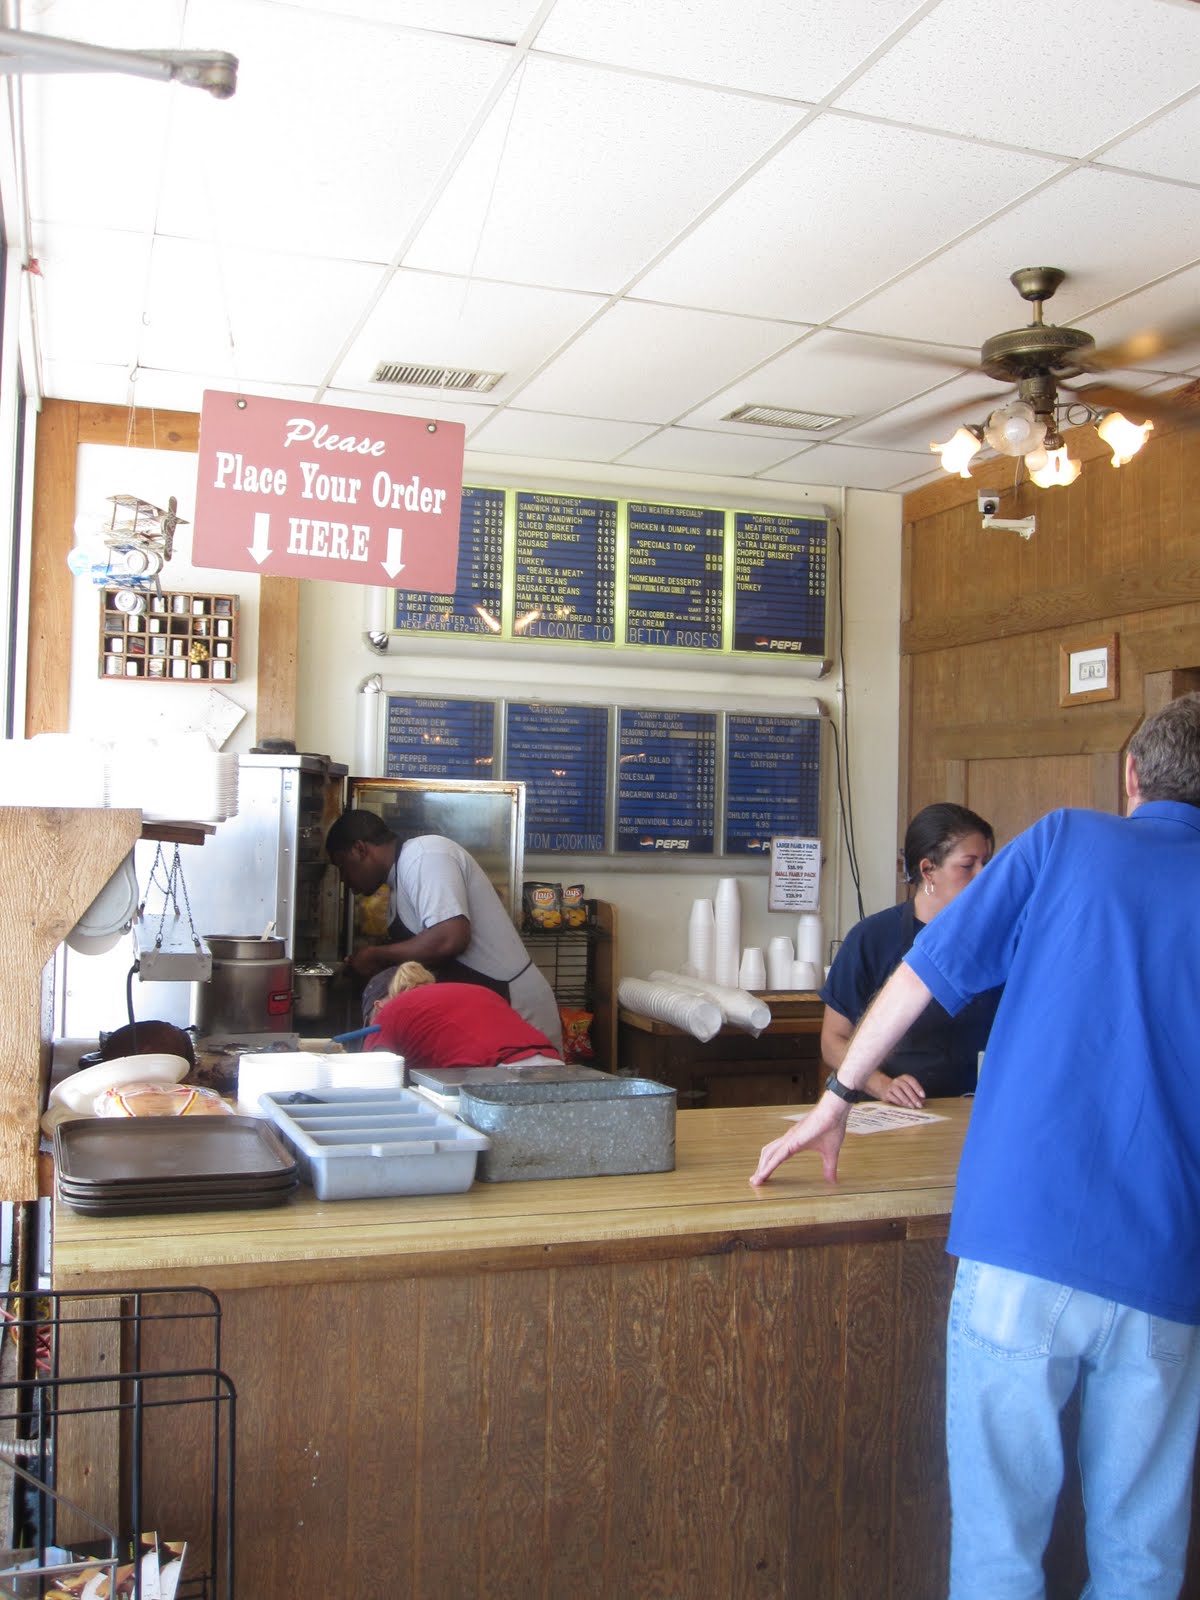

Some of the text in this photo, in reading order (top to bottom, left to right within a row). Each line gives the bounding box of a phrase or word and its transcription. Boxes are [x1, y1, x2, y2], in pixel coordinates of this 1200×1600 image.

[284, 418, 386, 457] Please
[214, 451, 446, 514] Place Your Order
[520, 503, 595, 516] SANDWICH ON THE LUNCH
[649, 507, 674, 515] WEATHER
[527, 513, 545, 521] MEAT
[548, 515, 582, 524] SANDWICH
[519, 521, 574, 532] SLICED BRISKET
[630, 522, 658, 531] CHICKEN
[668, 525, 700, 535] DUMPLINS
[745, 524, 761, 532] MEAT
[780, 527, 800, 535] POUND
[287, 518, 369, 562] HERE
[518, 530, 580, 542] CHOPPED BRISKET
[737, 532, 788, 542] SLICED BRISKET
[518, 539, 548, 548] SAUSAGE
[737, 541, 757, 549] X-TRA
[779, 544, 805, 553] BRISKET
[630, 548, 649, 556] PINTS
[737, 549, 794, 560] CHOPPED BRISKET
[518, 557, 544, 565] TURKEY
[737, 557, 765, 566] SAUSAGE
[546, 577, 567, 585] BEANS
[517, 584, 547, 593] SAUSAGE
[558, 587, 580, 595] BEANS
[737, 583, 761, 591] TURKEY
[407, 594, 427, 602] MEAT
[430, 596, 454, 604] COMBO
[542, 595, 564, 603] BEANS
[407, 604, 426, 612] MEAT
[430, 605, 454, 613] COMBO
[517, 602, 544, 610] TURKEY
[554, 605, 576, 613] BEANS
[426, 614, 436, 622] US
[469, 616, 487, 625] YOU
[541, 611, 546, 619] &
[629, 610, 646, 618] PEACH
[649, 610, 674, 619] COBBLER
[401, 620, 498, 634] NEXT EVENT 672-839
[594, 625, 611, 640] TO
[630, 628, 718, 647] BETTY ROSE'S
[770, 640, 802, 650] PEPSI
[390, 717, 427, 725] MOUNTAIN
[634, 720, 683, 729] FIXINS/SALADS
[390, 726, 405, 734] MUG
[409, 727, 427, 735] ROOT
[622, 729, 648, 737] SEASONED
[390, 735, 417, 743] PUNCHY
[400, 754, 428, 762] PEPPER
[734, 752, 794, 760] ALL-YOU-CAN-EAT
[389, 763, 405, 771] DIET
[620, 773, 655, 781] COLESLAW
[620, 790, 677, 800] MACARONI SALAD
[556, 834, 602, 849] COOKING
[655, 840, 689, 849] PEPSI
